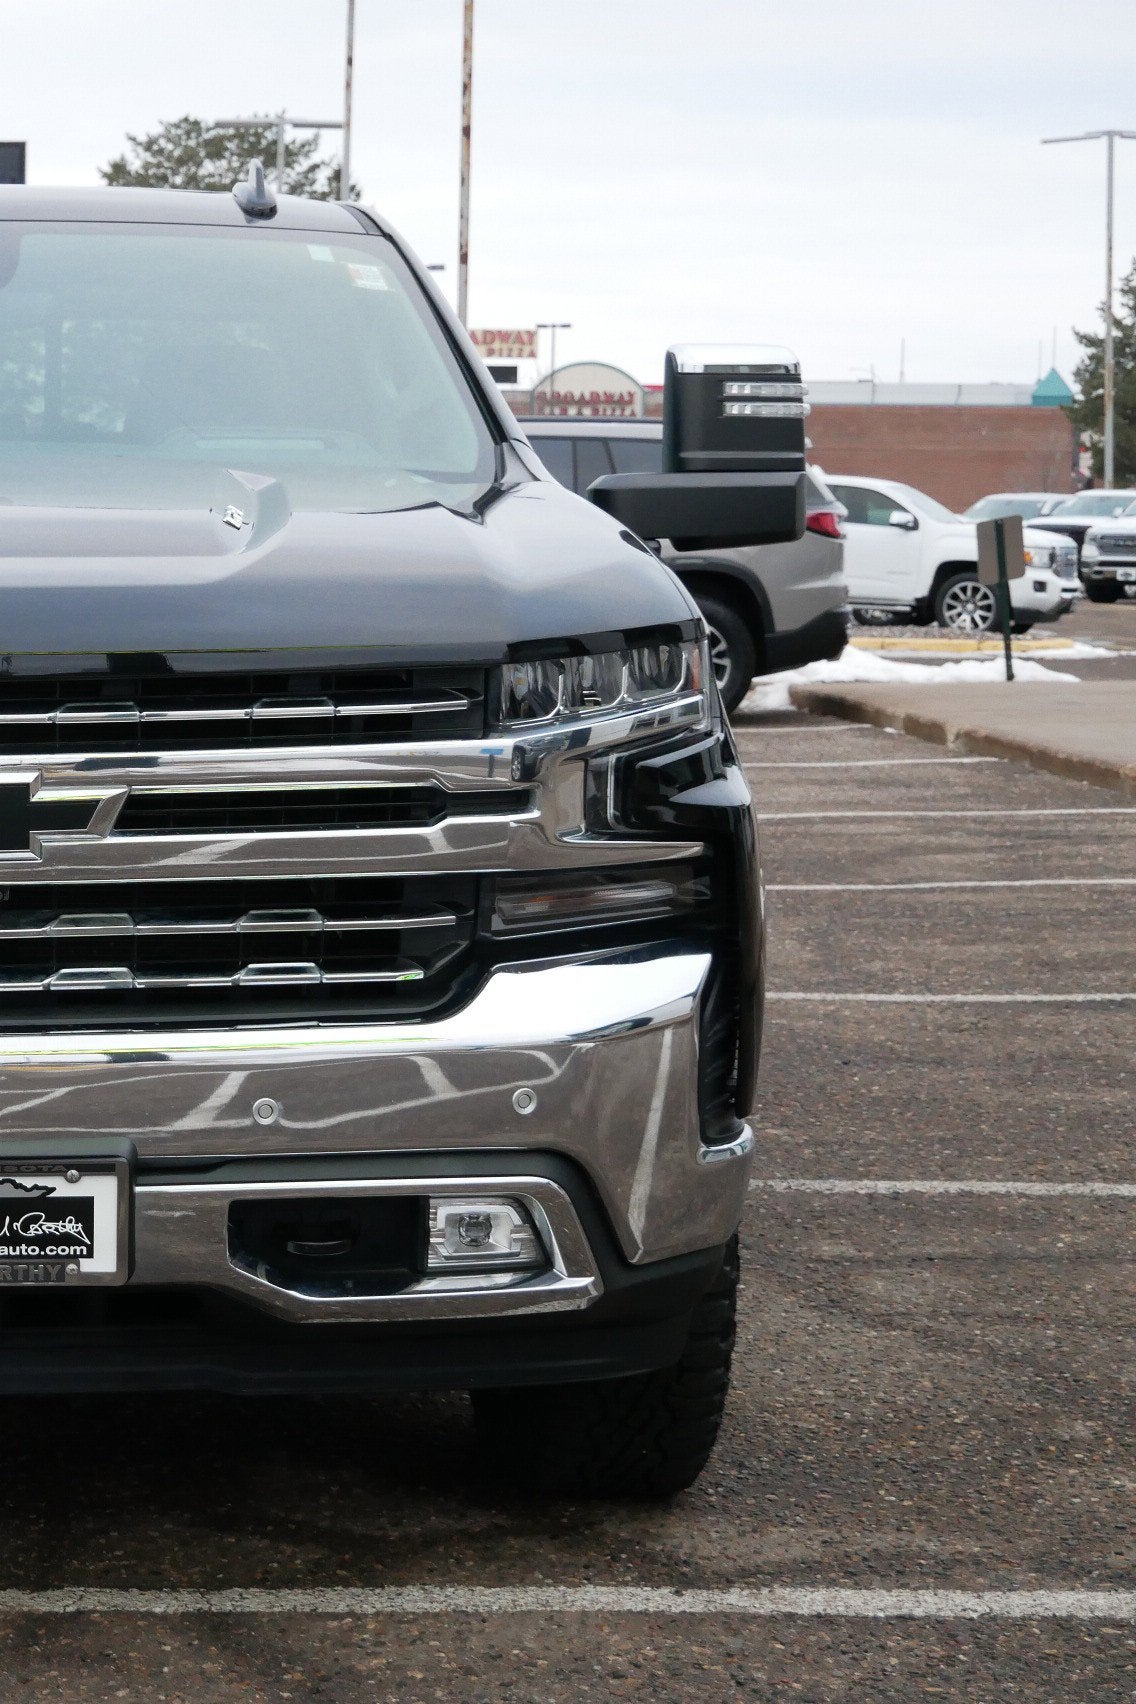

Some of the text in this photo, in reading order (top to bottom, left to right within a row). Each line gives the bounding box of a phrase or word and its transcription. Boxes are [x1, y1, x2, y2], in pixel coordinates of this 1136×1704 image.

[469, 330, 537, 345] ADWAY
[486, 347, 537, 358] PIZZA
[535, 391, 635, 405] BROADWAY
